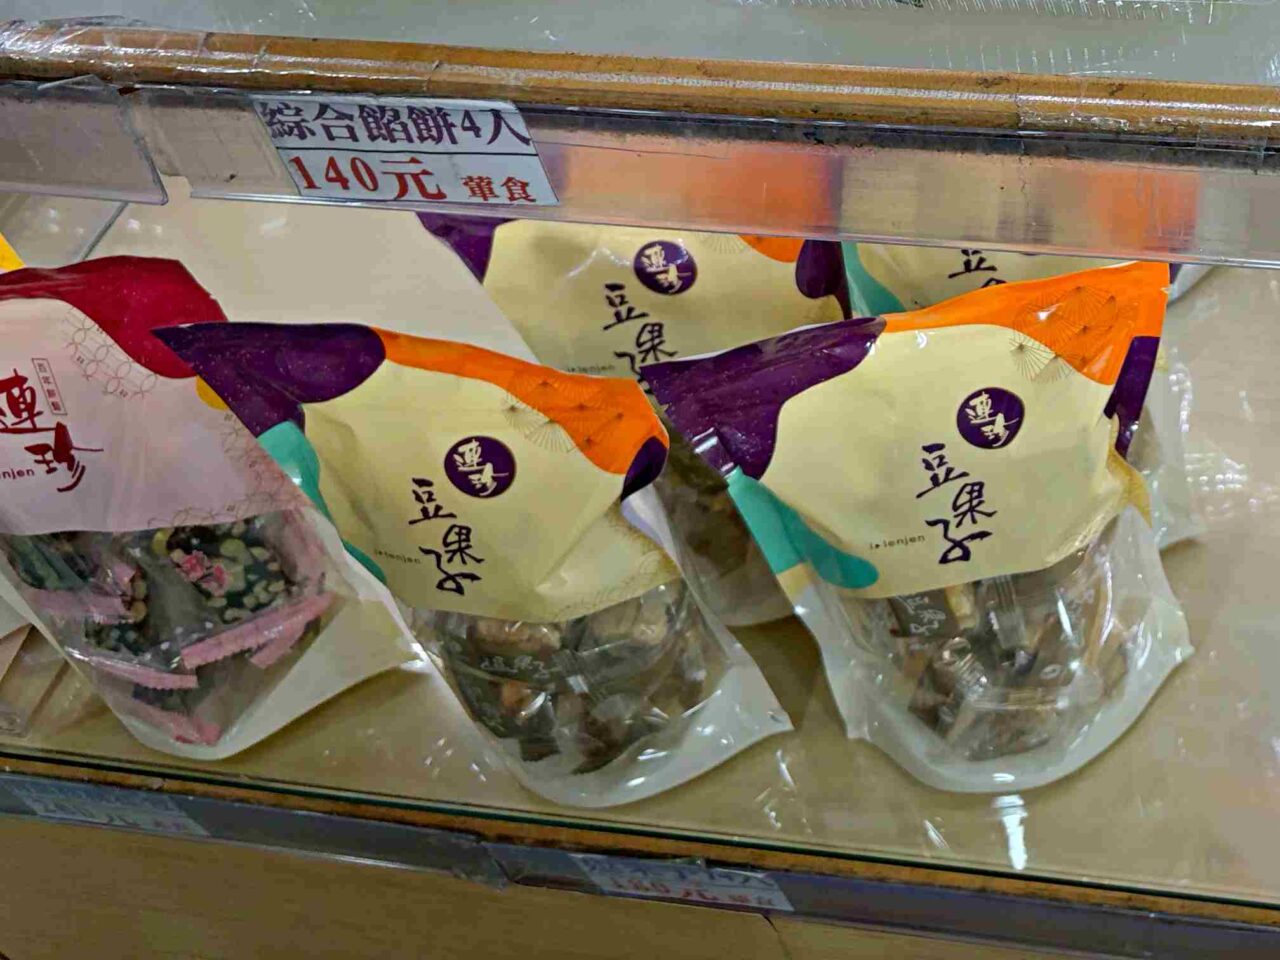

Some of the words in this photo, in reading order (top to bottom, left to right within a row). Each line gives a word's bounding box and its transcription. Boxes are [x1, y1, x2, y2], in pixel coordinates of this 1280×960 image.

[260, 102, 534, 145] 綜合餡餅4入
[289, 156, 447, 200] 140元
[460, 176, 537, 202] 葷食
